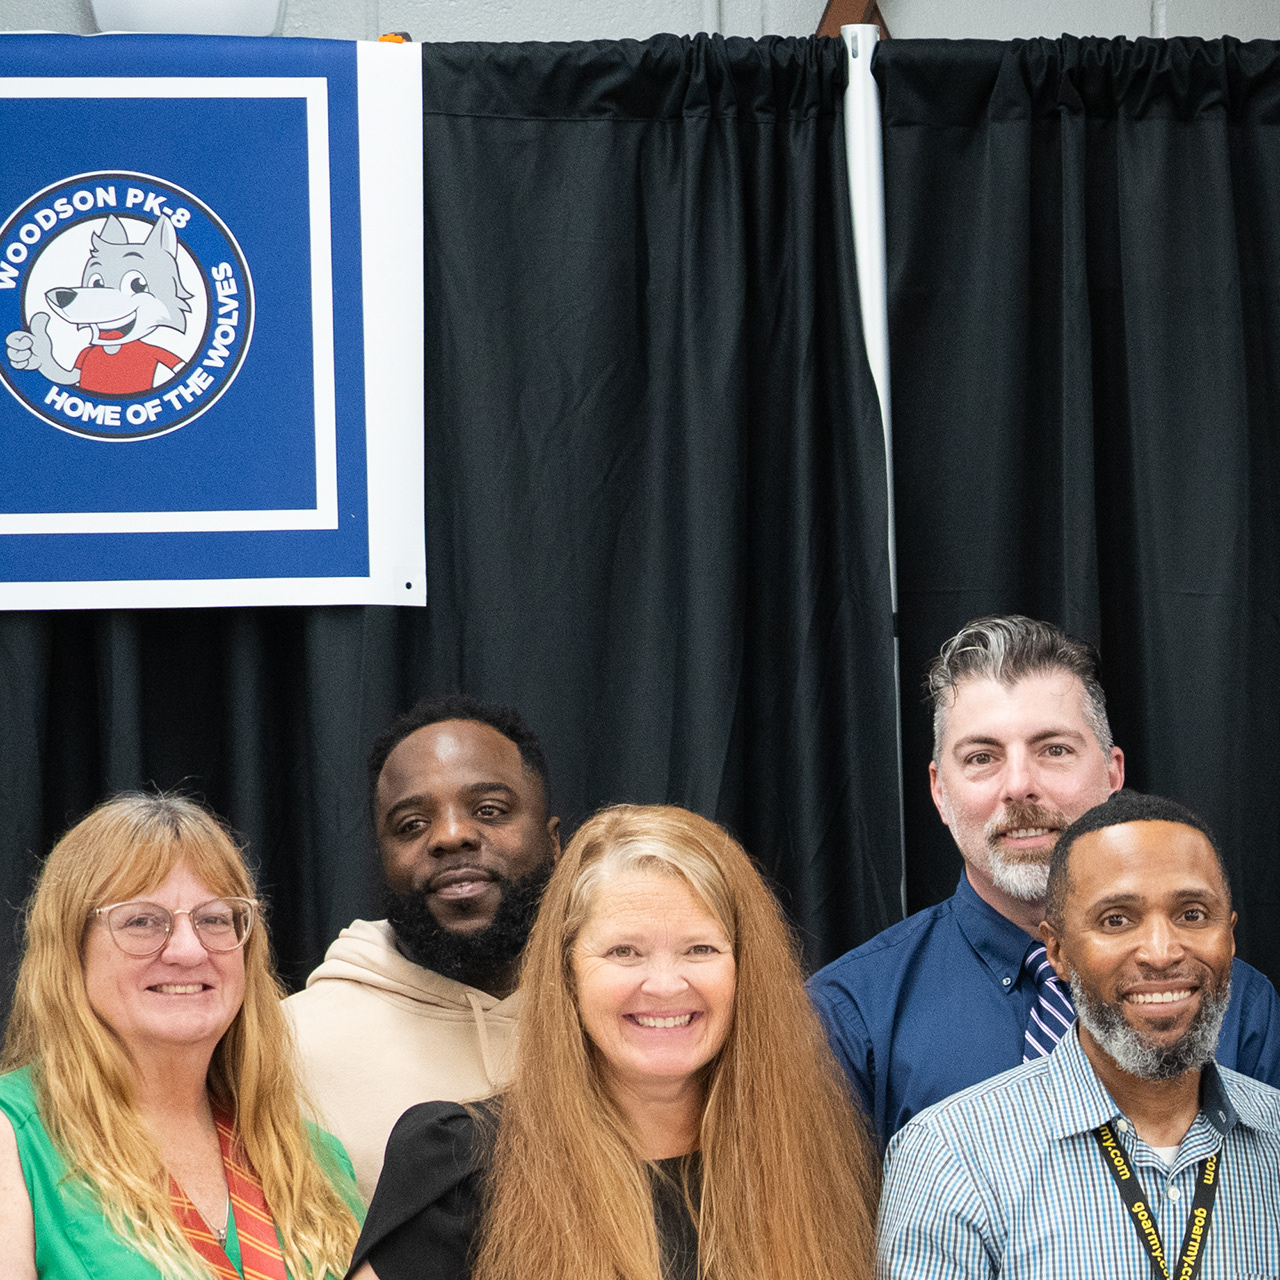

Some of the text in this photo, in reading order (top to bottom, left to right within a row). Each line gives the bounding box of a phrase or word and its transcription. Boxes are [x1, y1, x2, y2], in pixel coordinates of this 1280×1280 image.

[0, 186, 192, 290] WOODSON PK-8
[44, 261, 239, 426] HOME OF THE WOLVES
[1099, 1125, 1131, 1180] my.com
